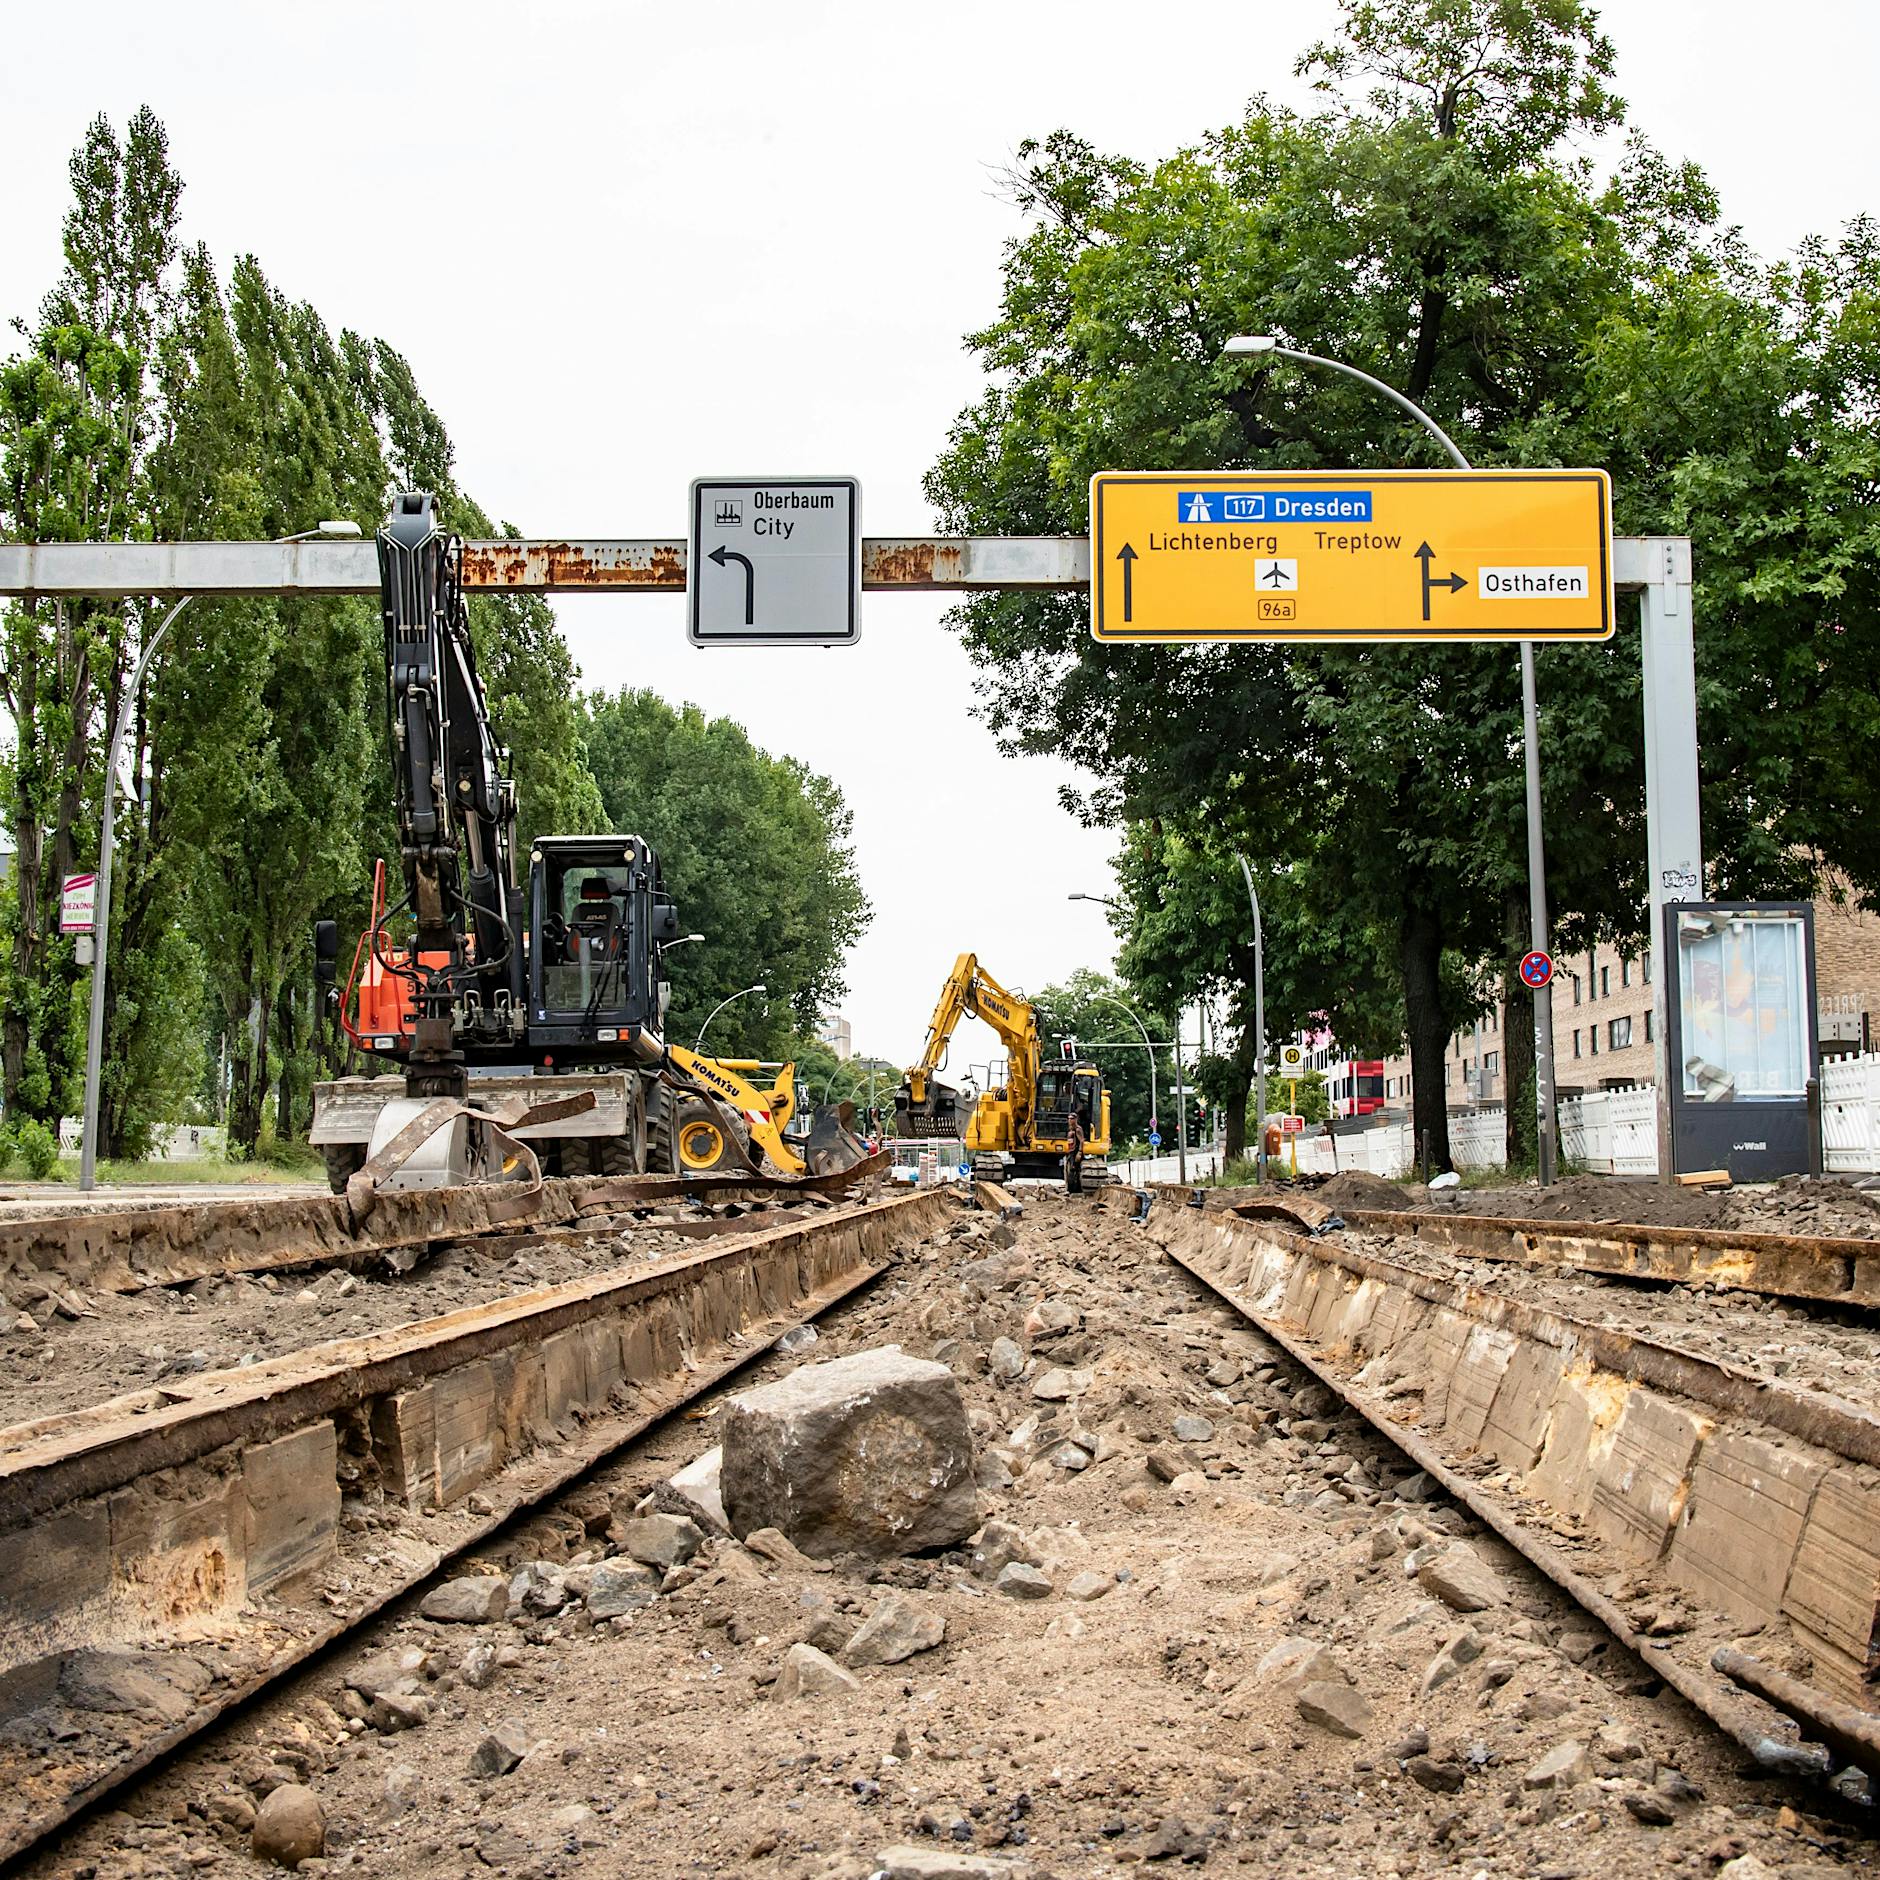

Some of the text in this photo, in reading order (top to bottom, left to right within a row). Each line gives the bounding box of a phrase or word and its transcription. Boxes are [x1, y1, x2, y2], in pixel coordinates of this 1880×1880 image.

[754, 491, 834, 509] Oberbaum
[1232, 498, 1366, 517] 117 Dresden
[753, 517, 794, 539] City
[1149, 532, 1277, 554] Lichtenberg
[1314, 531, 1402, 553] Treptow
[1486, 573, 1582, 592] Osthafen
[1262, 603, 1291, 617] 96a
[982, 993, 1010, 1020] KOMATSU
[691, 1060, 740, 1097] KOMATSU
[1743, 1141, 1767, 1151] Wall
